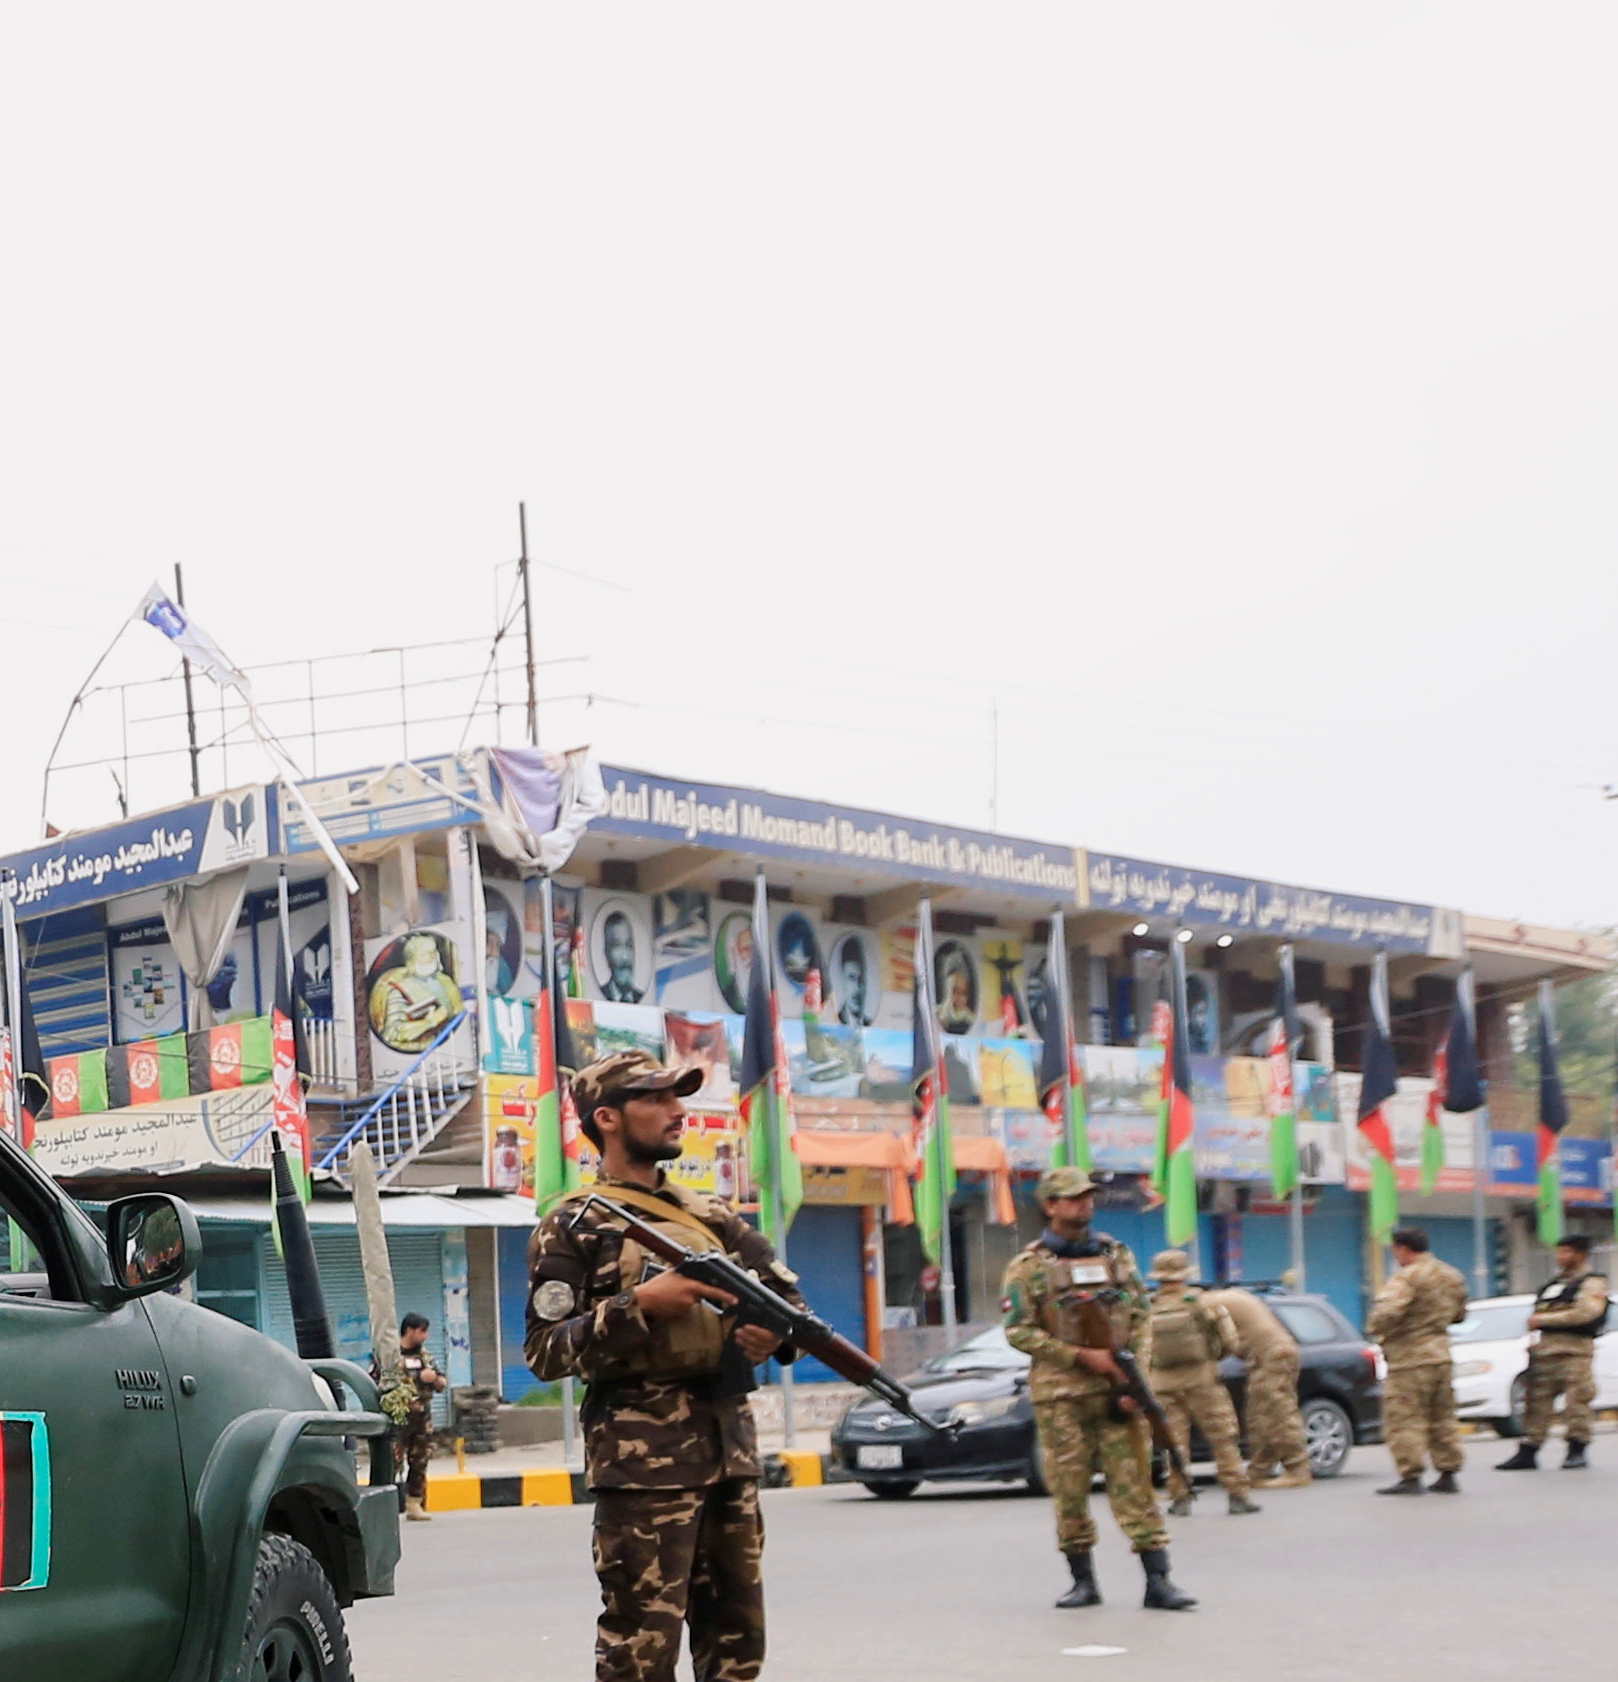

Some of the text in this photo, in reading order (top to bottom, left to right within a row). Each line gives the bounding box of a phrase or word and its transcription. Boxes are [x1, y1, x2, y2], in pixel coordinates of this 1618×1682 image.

[651, 787, 739, 840] Majeed
[740, 803, 838, 850] Momand
[839, 819, 894, 860] Book
[894, 829, 946, 869] Bank
[946, 837, 965, 872] &
[965, 842, 1077, 890] Publications
[115, 1369, 161, 1391] HILUX
[300, 1600, 334, 1665] PIRELLI
